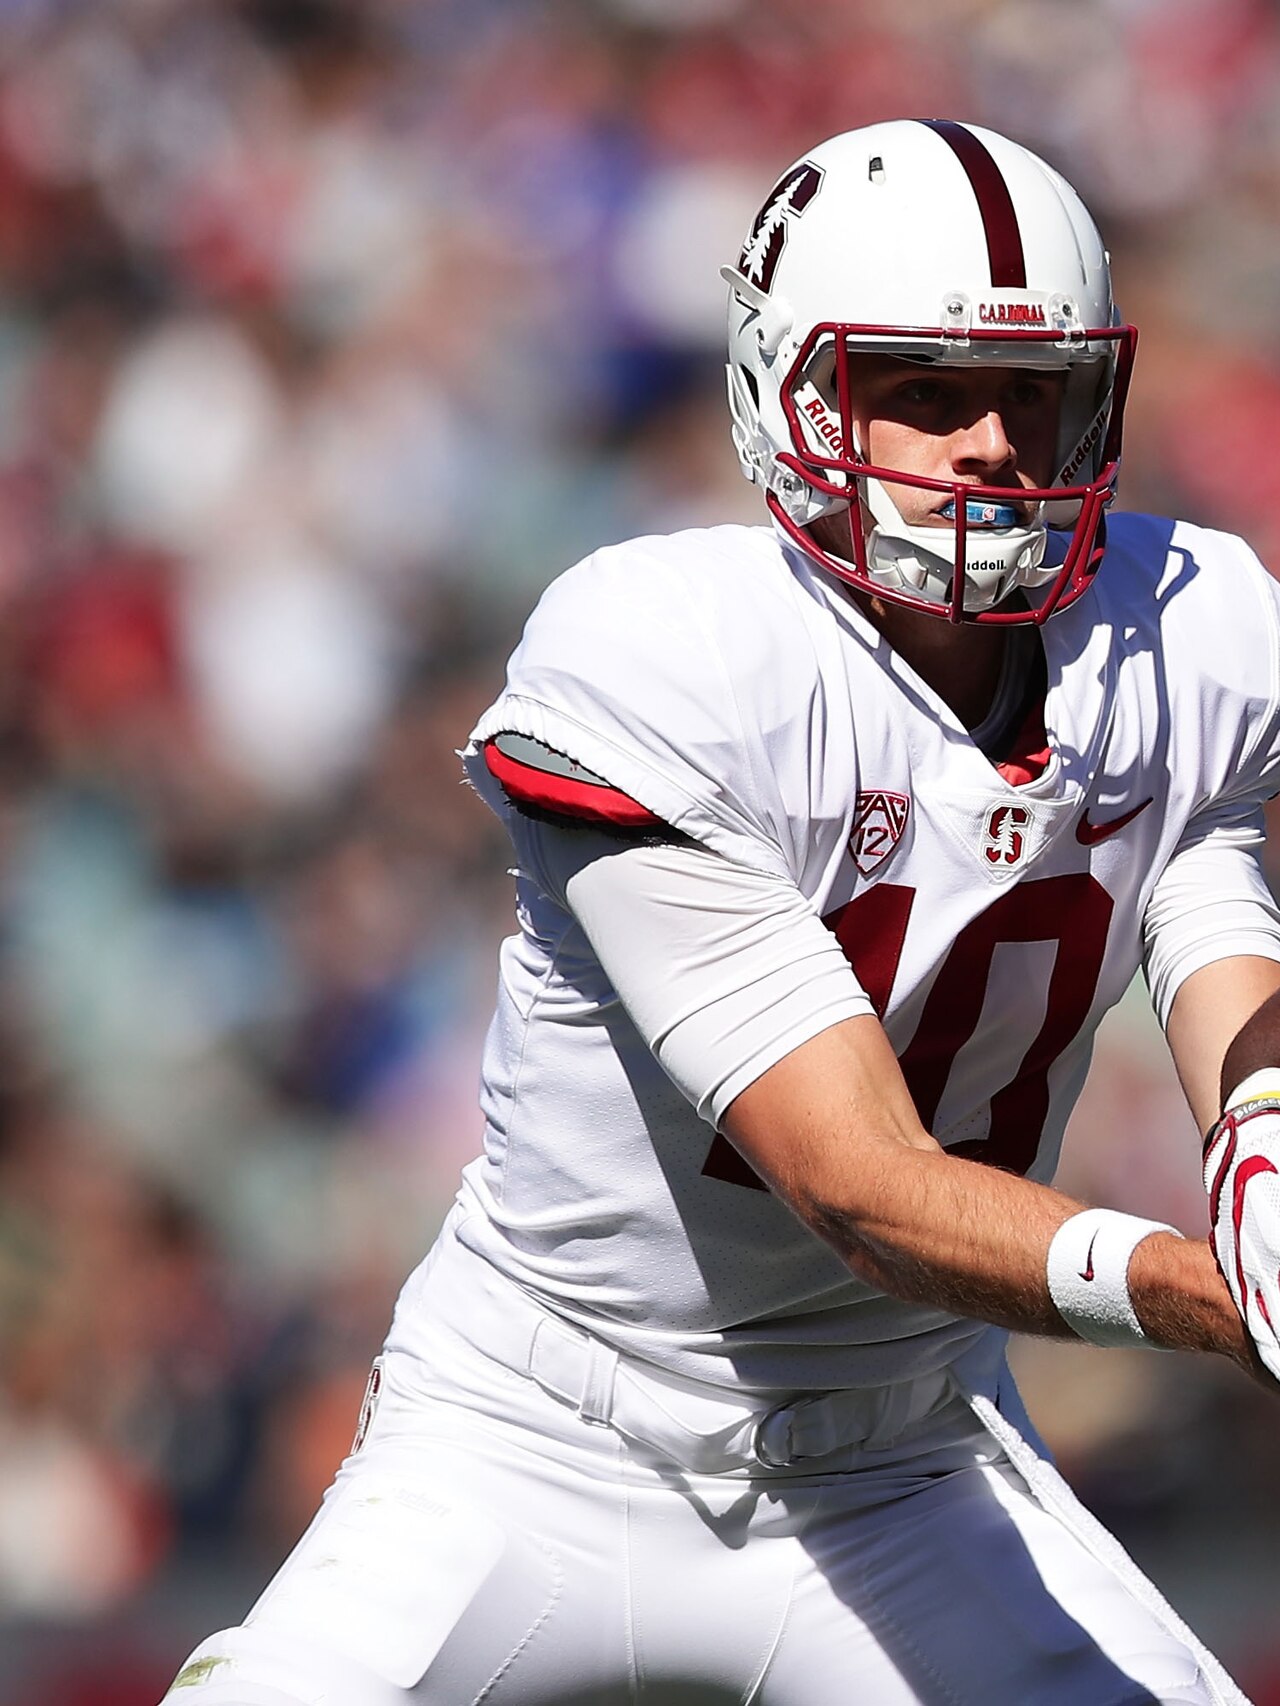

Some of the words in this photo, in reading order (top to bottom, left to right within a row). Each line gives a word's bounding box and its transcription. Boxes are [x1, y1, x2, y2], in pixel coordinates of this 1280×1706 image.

[978, 303, 1045, 326] CARDINAL
[804, 398, 844, 460] Ridd
[856, 826, 890, 857] 12
